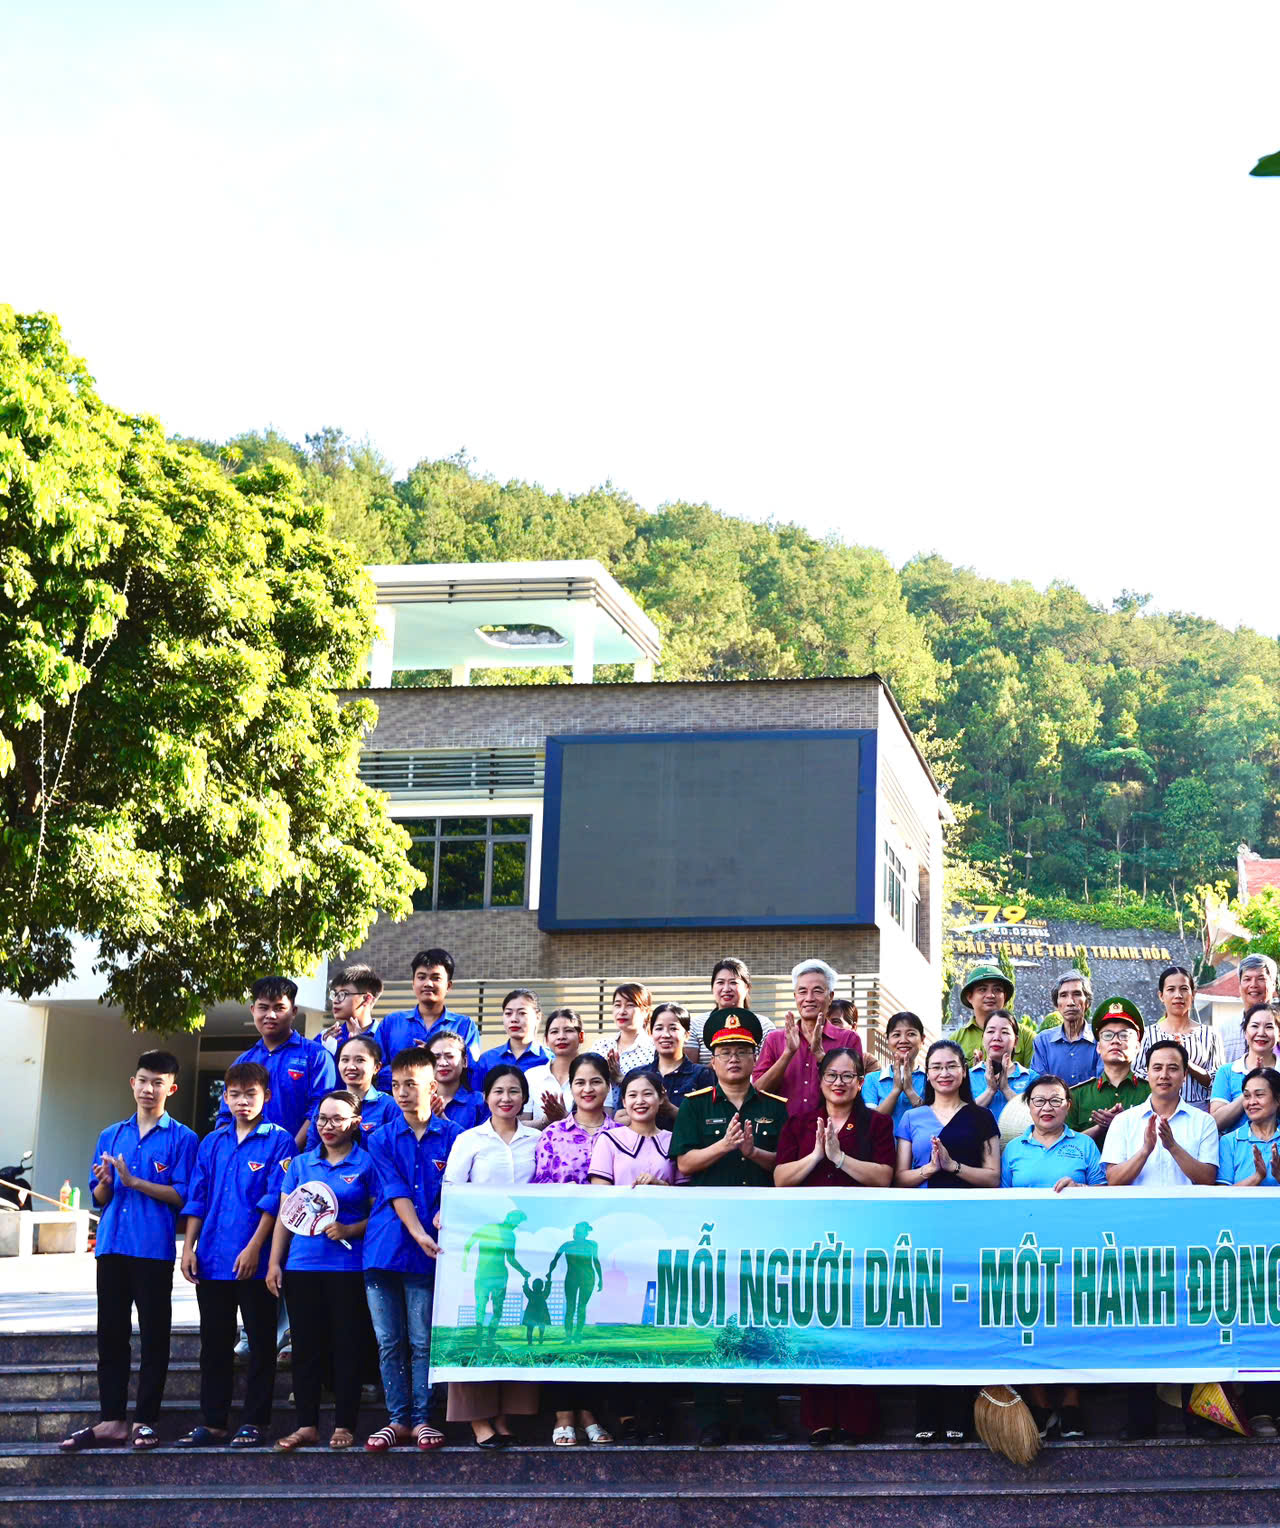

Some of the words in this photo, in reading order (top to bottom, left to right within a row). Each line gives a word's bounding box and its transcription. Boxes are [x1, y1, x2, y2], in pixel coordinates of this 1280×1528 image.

[973, 905, 1027, 924] 79
[1090, 945, 1140, 960] THANH
[1140, 944, 1171, 960] HÓA
[655, 1222, 728, 1328] MỖI
[737, 1231, 854, 1329] NGƯỜI
[863, 1233, 943, 1328] DÂN
[979, 1232, 1063, 1346] MỘT
[1071, 1231, 1177, 1328] HÀNH
